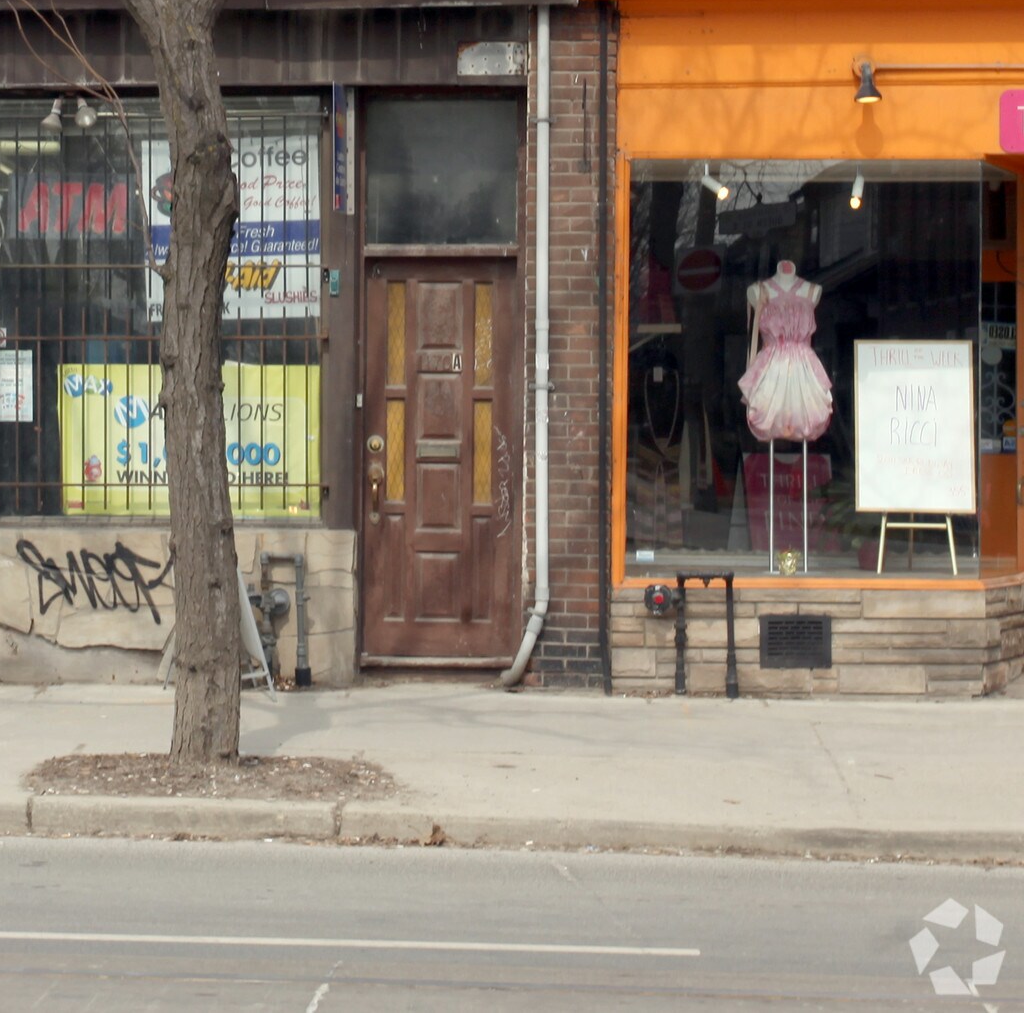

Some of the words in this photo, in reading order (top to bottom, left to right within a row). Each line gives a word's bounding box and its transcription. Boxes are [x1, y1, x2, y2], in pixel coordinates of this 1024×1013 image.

[18, 181, 128, 235] ATM
[236, 225, 275, 239] Fresh
[250, 238, 319, 254] Guaranteed!
[895, 384, 938, 412] NINA
[890, 416, 937, 447] RICCI
[242, 471, 289, 485] HERE!
